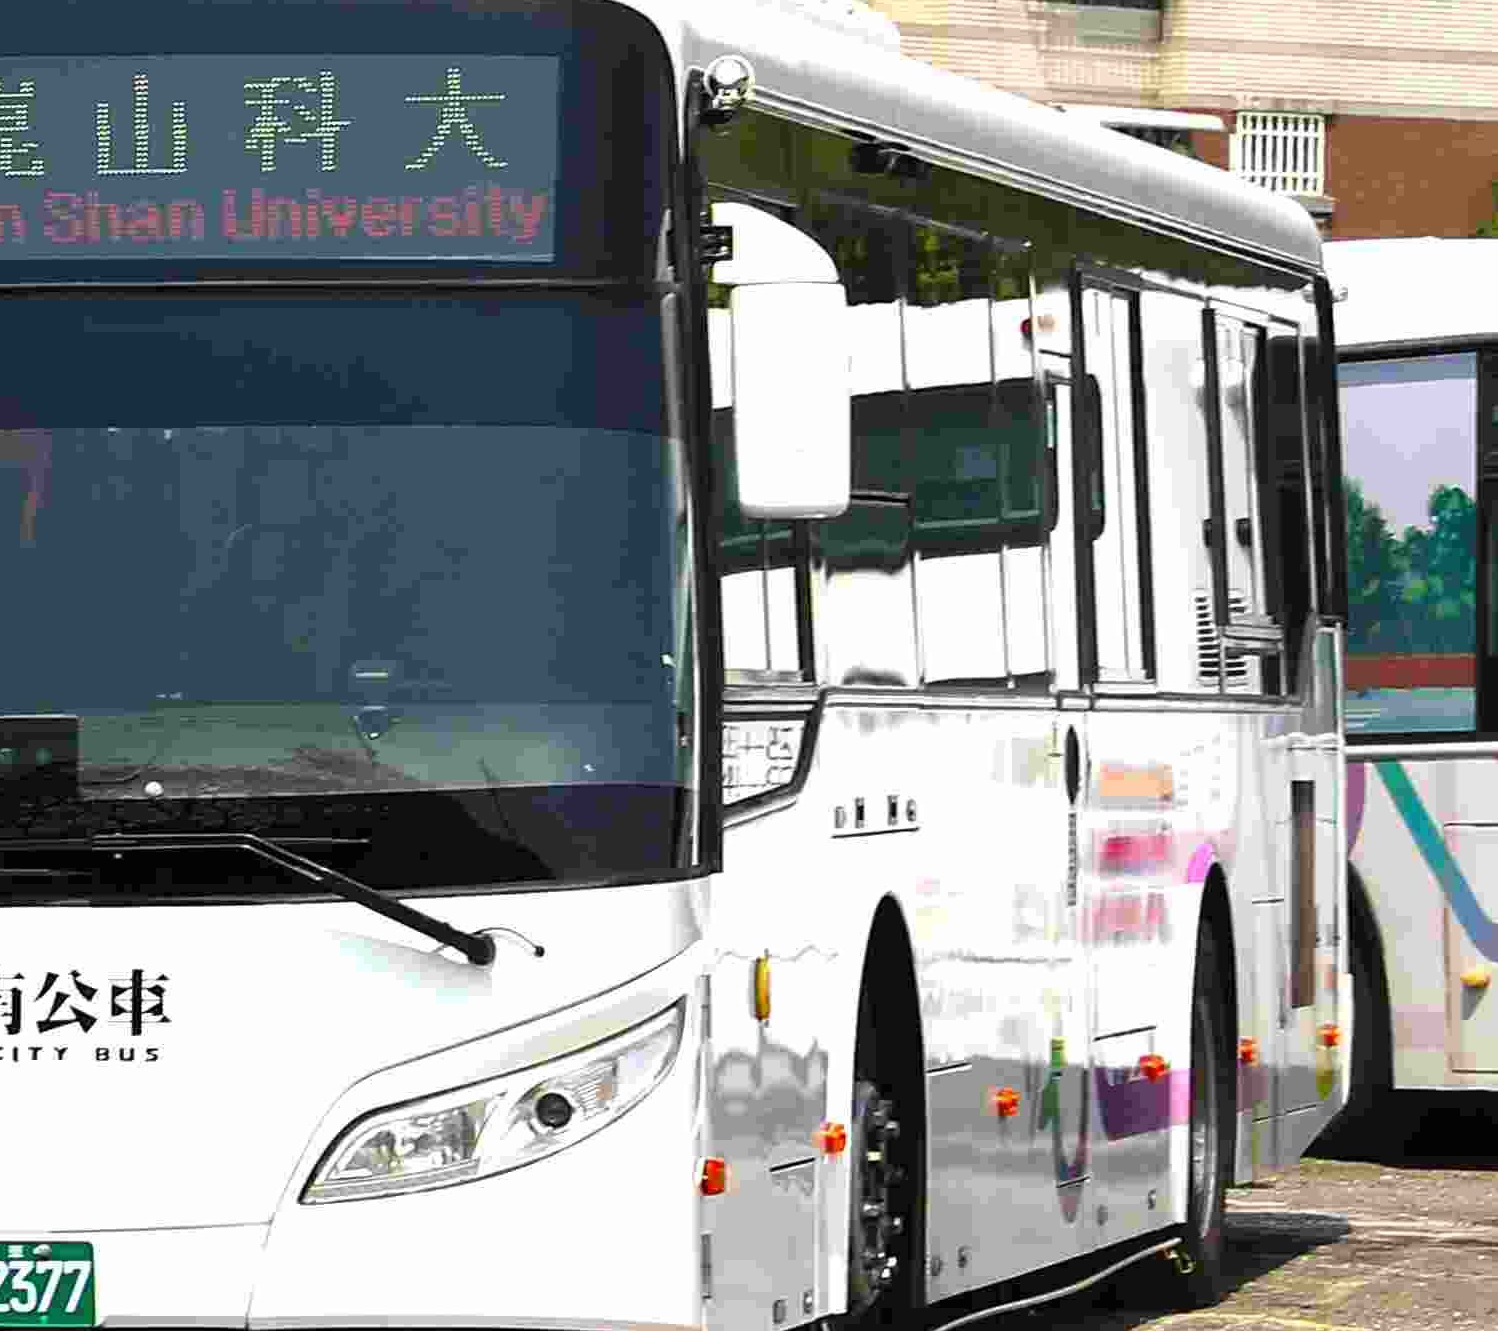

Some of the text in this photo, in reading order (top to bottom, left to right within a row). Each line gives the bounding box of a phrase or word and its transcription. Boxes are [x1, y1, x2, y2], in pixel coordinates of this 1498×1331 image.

[42, 186, 206, 245] Shan
[221, 180, 548, 246] University
[95, 1046, 159, 1063] BUS
